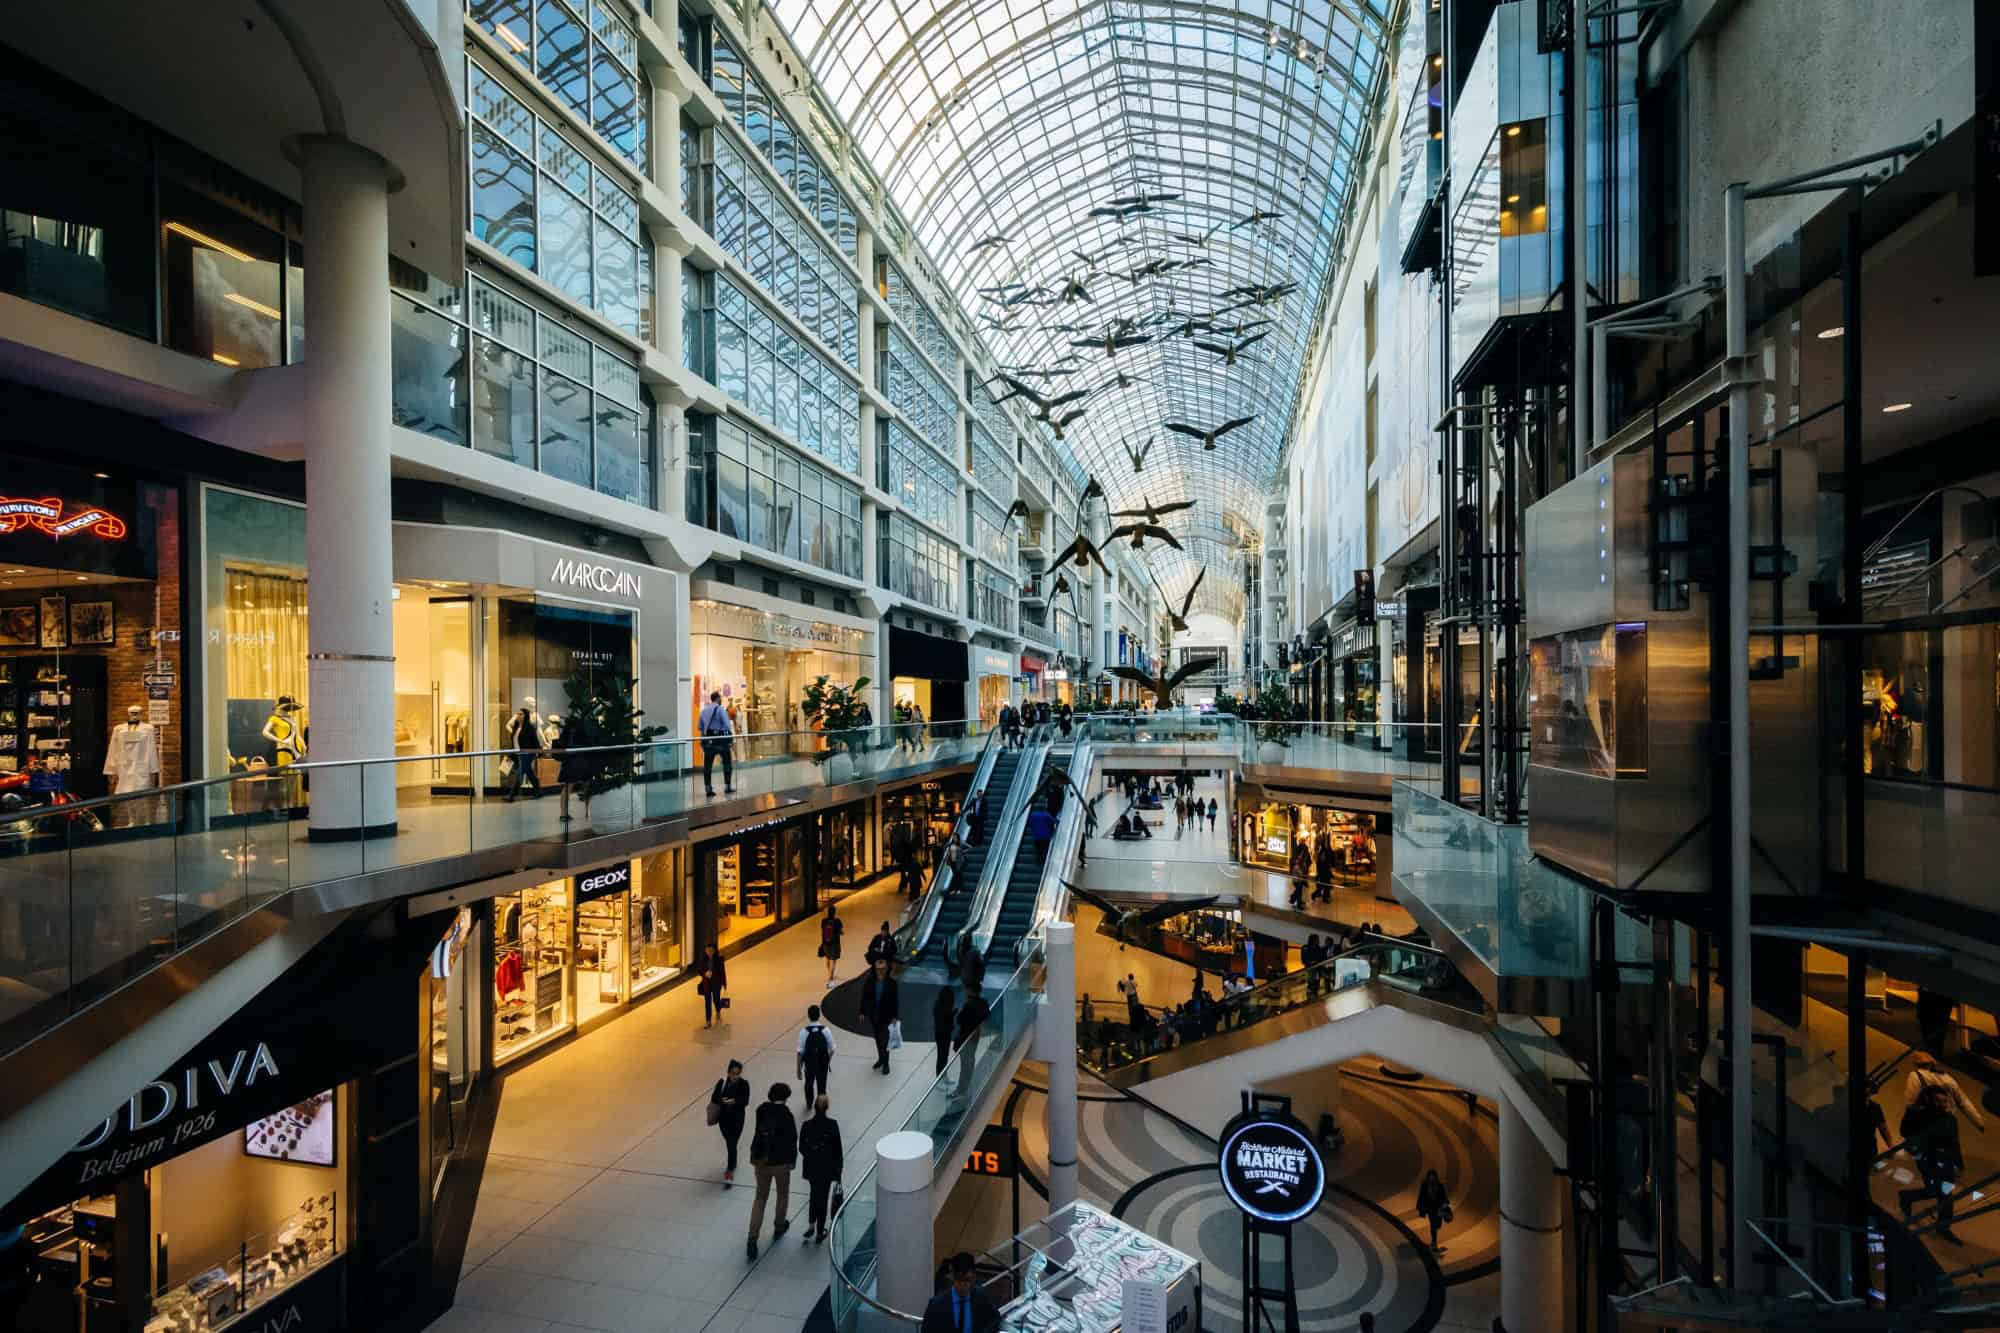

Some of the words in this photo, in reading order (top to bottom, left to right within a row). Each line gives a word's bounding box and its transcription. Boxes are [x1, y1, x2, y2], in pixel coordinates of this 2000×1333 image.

[580, 868, 628, 893] GEOX
[79, 1135, 167, 1184] Belgium
[173, 1109, 217, 1145] 1926
[963, 1151, 999, 1174] TS
[1237, 1150, 1308, 1174] MARKET
[1244, 1169, 1300, 1185] RESTAURANTS
[249, 1304, 301, 1333] IVA
